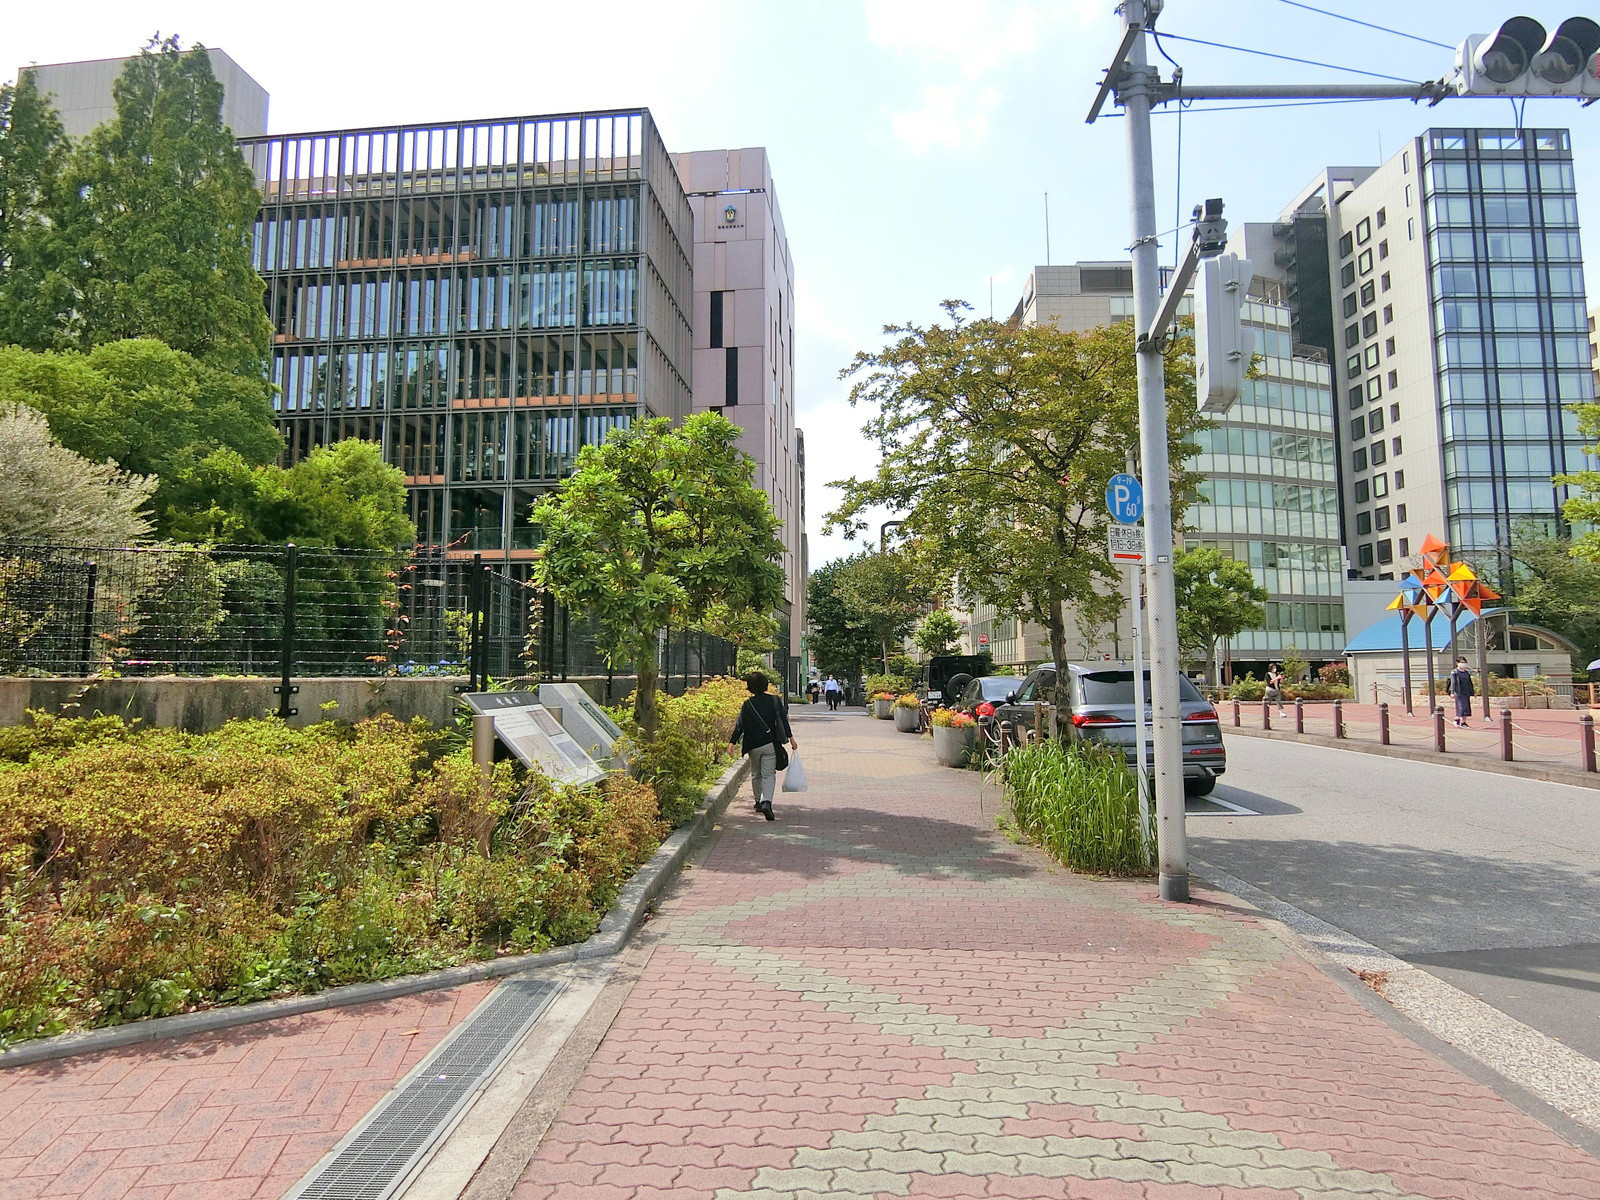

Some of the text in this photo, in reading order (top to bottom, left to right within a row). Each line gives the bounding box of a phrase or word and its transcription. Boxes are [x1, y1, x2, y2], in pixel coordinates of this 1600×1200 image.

[1116, 476, 1132, 485] 9-19
[1115, 485, 1129, 515] P
[1126, 503, 1137, 516] 60
